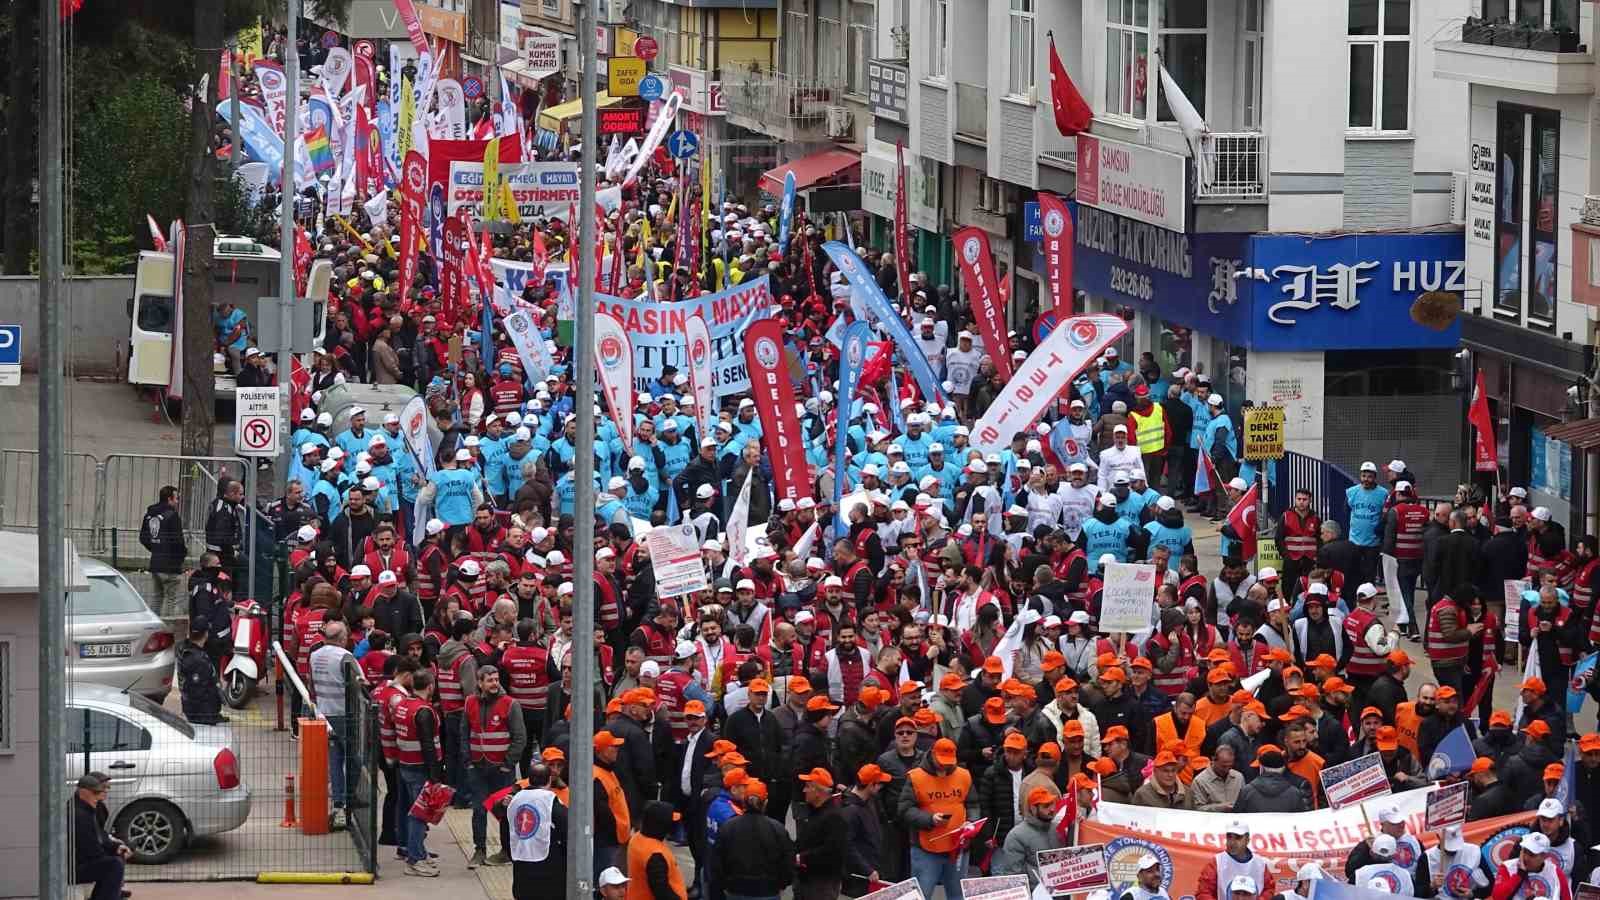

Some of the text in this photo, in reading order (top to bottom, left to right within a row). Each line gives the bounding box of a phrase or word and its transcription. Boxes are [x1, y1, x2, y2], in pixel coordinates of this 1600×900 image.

[616, 69, 638, 77] ZAFER
[1101, 148, 1130, 173] SAMSUN
[1101, 176, 1123, 208] BÖLGE
[1254, 411, 1275, 422] 7/24
[1250, 421, 1280, 432] DENİZ
[1250, 432, 1278, 443] TAKSİ
